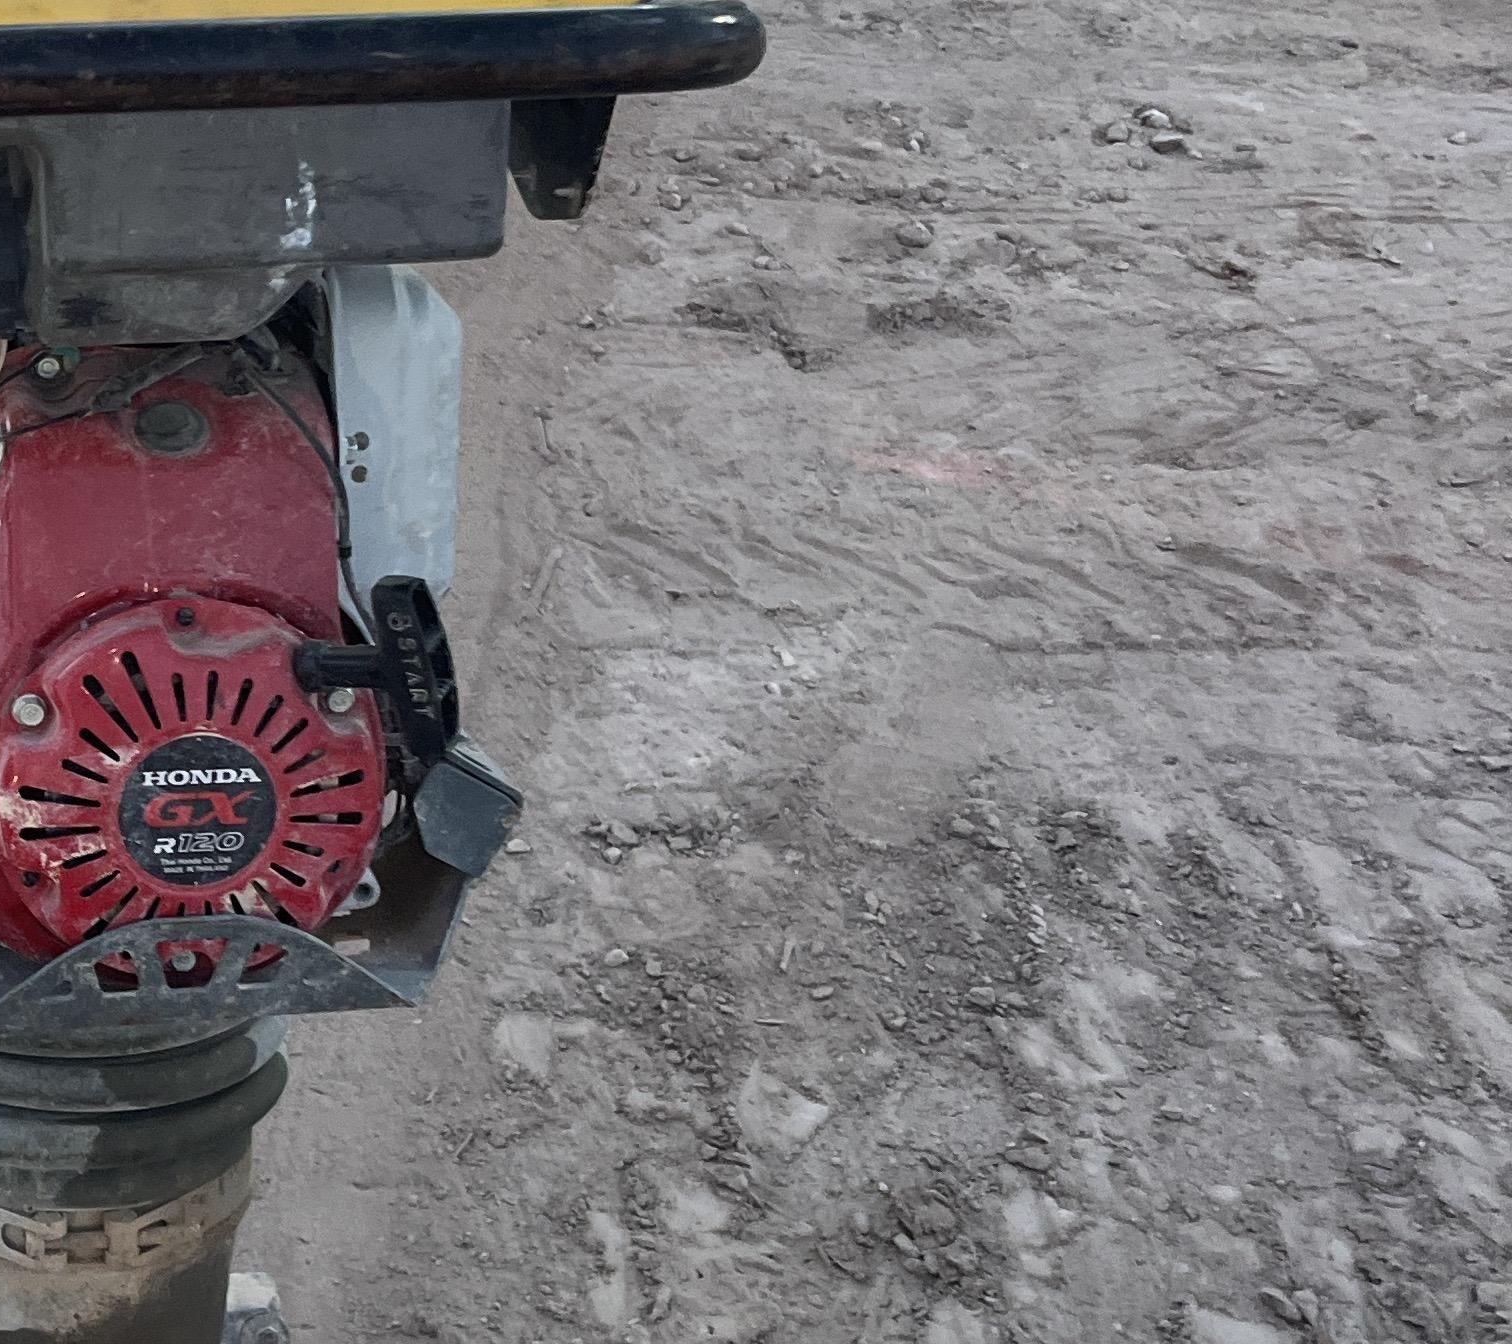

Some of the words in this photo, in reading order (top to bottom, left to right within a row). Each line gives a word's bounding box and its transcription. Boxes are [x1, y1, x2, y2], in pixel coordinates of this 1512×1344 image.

[396, 636, 436, 720] START
[142, 768, 262, 786] HONDA
[144, 789, 257, 828] GX
